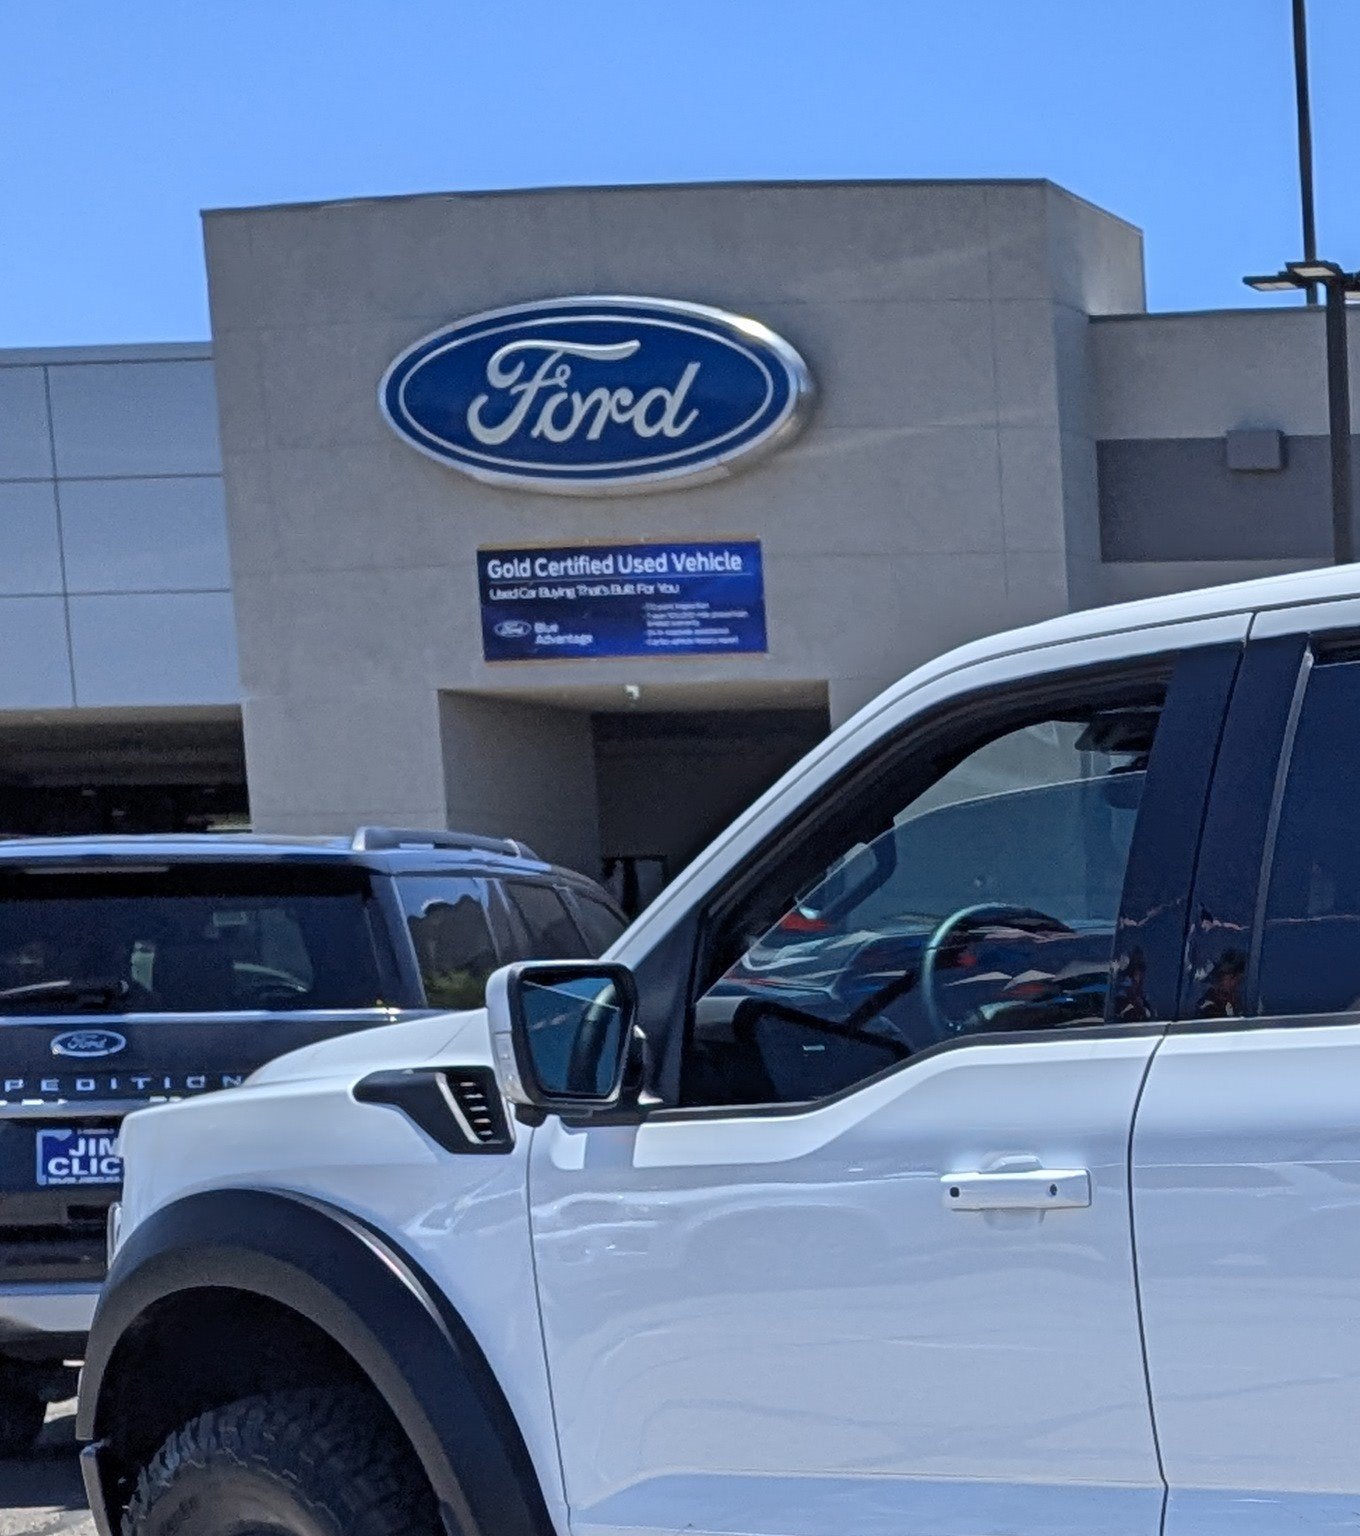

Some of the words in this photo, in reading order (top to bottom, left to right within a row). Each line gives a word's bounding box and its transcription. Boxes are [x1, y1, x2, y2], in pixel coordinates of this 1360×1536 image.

[466, 338, 701, 446] Ford
[486, 557, 531, 579] Gold
[534, 553, 615, 577] Certified
[617, 552, 668, 574] Used
[670, 549, 743, 572] Vehicle
[636, 583, 655, 595] For
[657, 582, 680, 594] You
[66, 1033, 108, 1050] Ford
